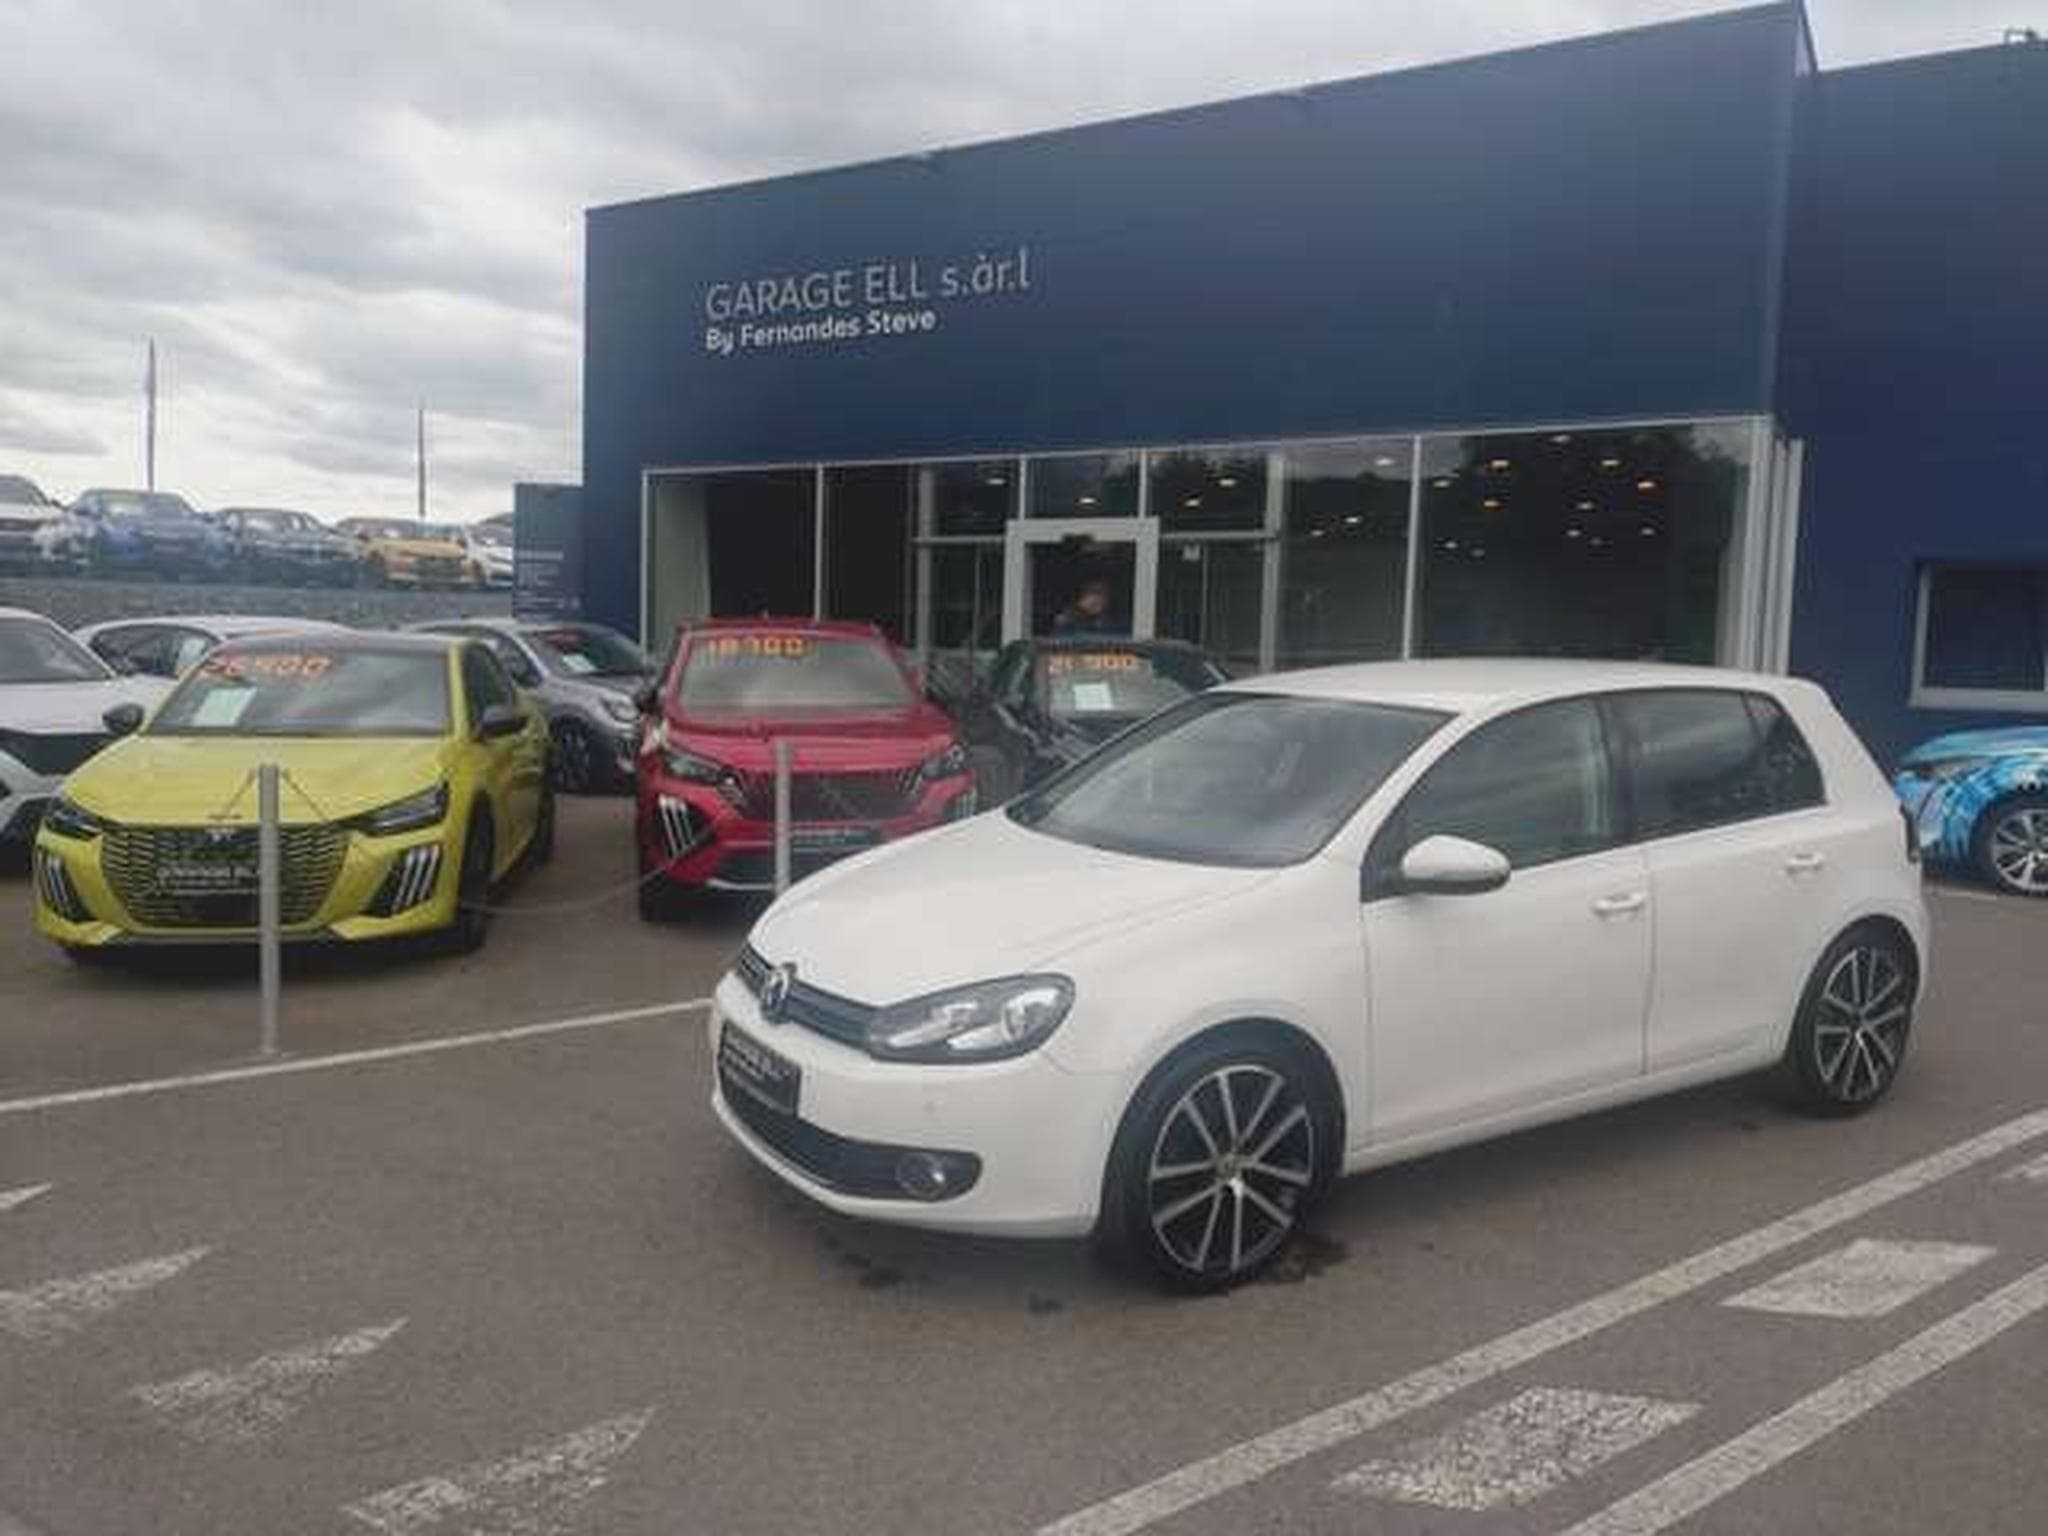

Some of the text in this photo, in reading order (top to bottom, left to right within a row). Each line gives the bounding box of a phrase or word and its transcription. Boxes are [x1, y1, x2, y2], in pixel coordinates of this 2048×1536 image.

[705, 268, 854, 321] GARAGE
[865, 260, 928, 304] ELL
[706, 309, 937, 355] By Fernandes Steve
